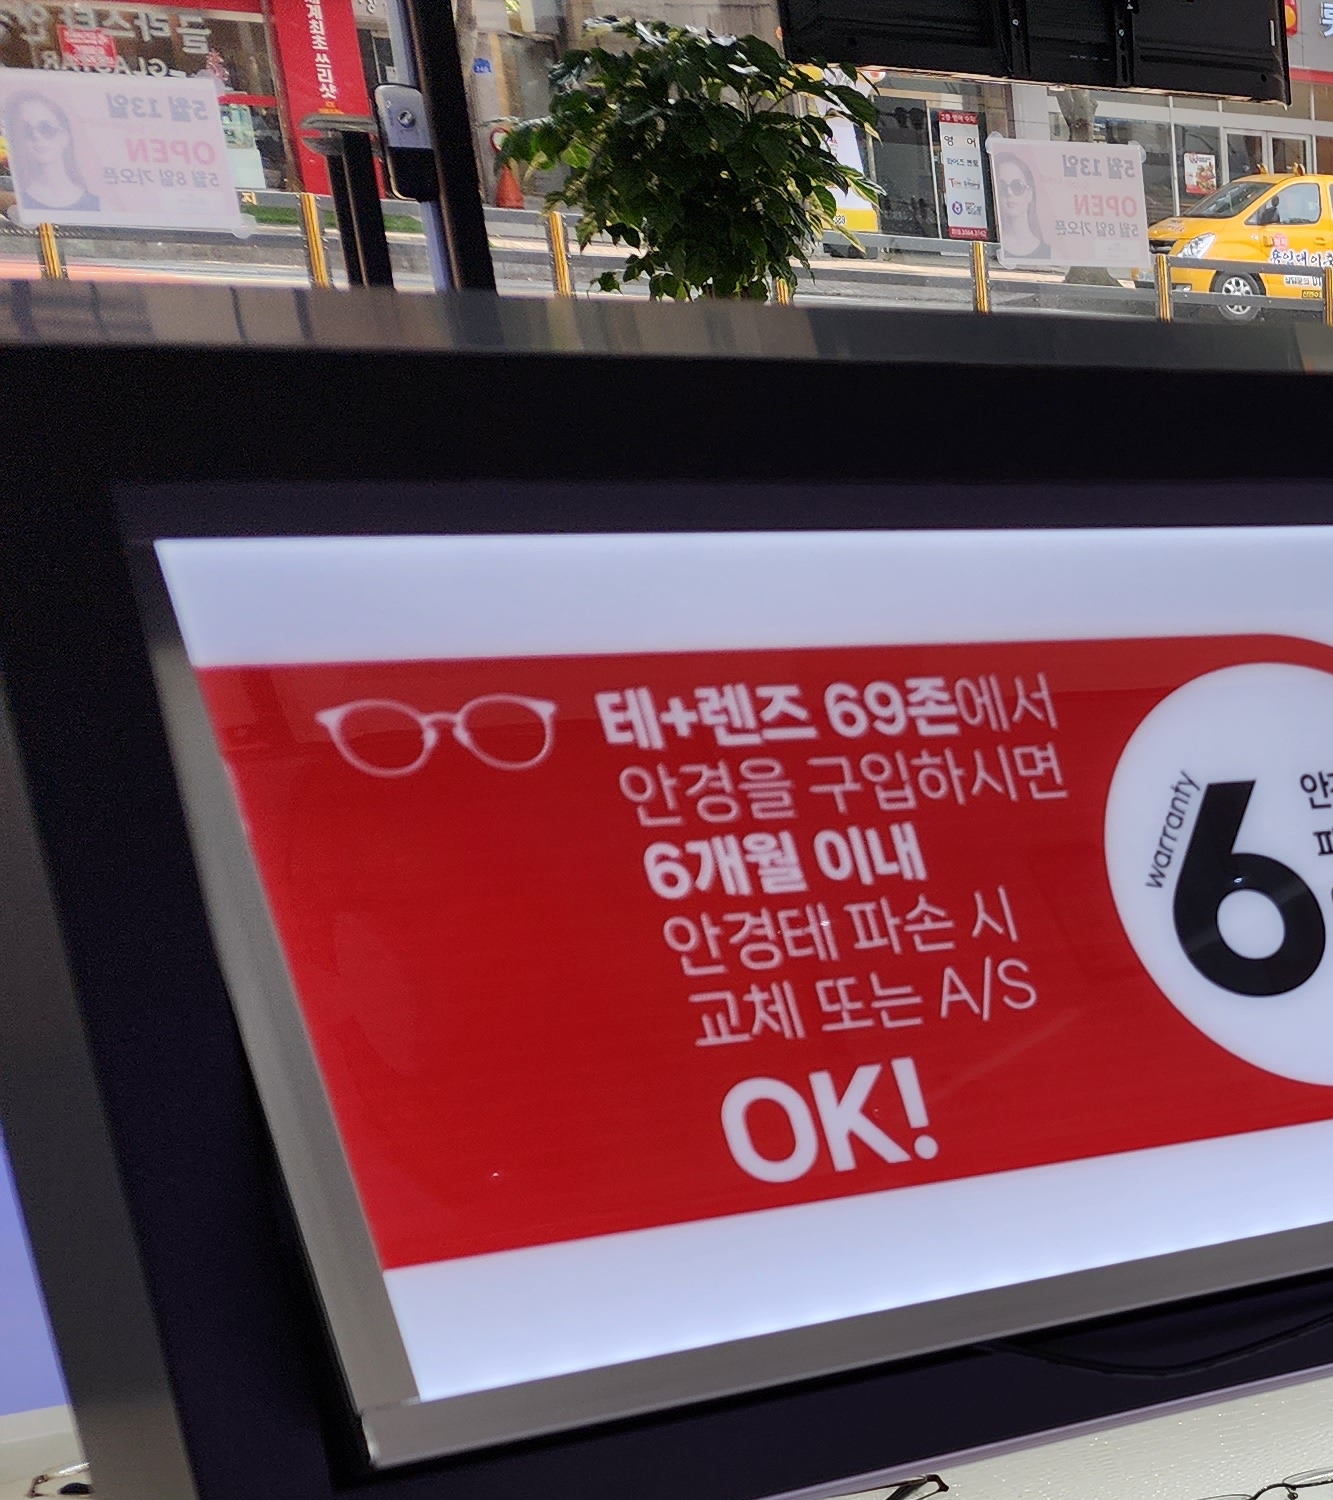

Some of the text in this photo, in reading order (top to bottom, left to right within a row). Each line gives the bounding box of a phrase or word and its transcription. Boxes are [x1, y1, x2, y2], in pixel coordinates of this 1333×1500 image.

[594, 672, 1060, 750] 테+렌즈 69존에서
[618, 742, 1070, 829] 안경을 구입하시면
[1144, 769, 1201, 890] warranty
[643, 822, 928, 900] 6개월 이내
[1172, 779, 1327, 998] 6
[662, 886, 1020, 981] 안경테 파손 시
[689, 956, 1037, 1049] 교체 또는 A/S
[719, 1056, 940, 1185] OK!
